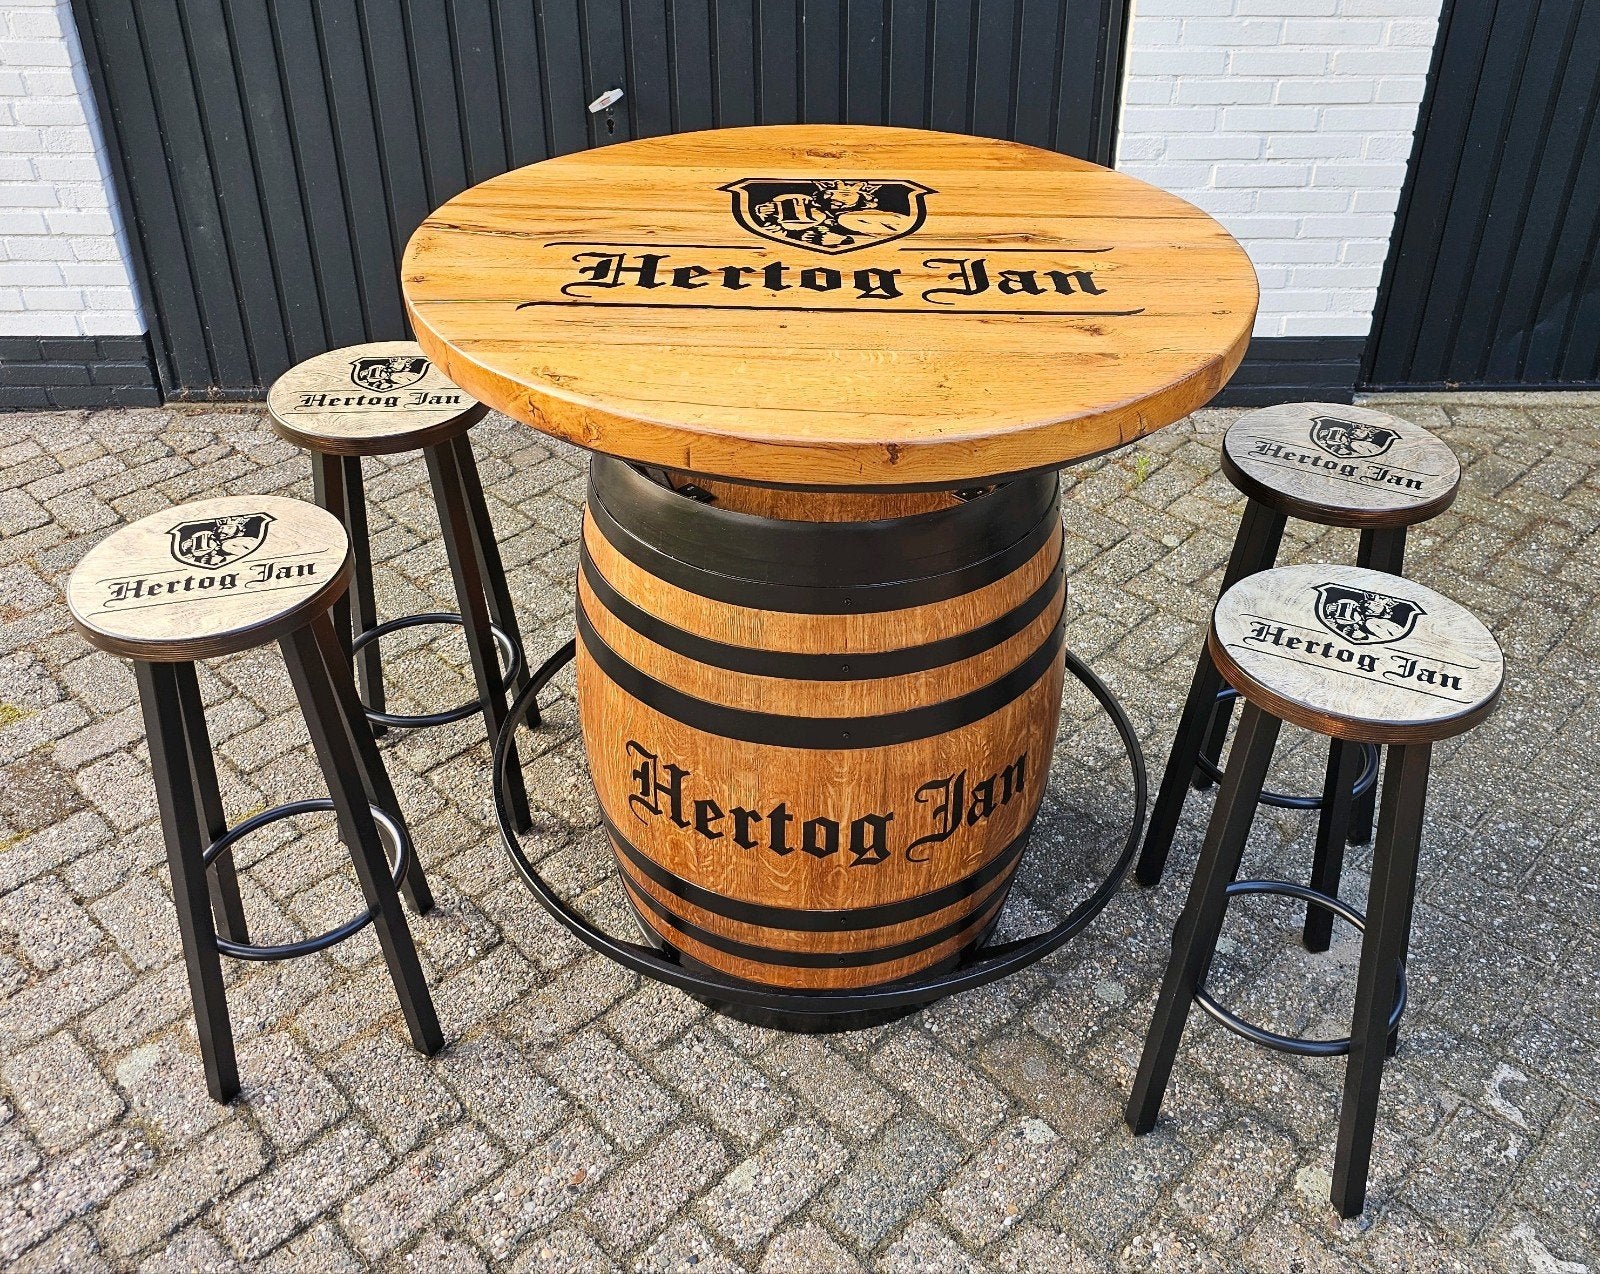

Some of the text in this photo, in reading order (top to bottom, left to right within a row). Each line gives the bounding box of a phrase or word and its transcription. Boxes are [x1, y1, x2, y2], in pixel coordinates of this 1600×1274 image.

[561, 252, 1107, 305] Hertog Jan
[294, 392, 461, 411] Hertog Jan
[1248, 440, 1424, 491] Hertog Jan
[103, 562, 317, 607] Hertog Jan
[1242, 621, 1462, 691] Hertog Jan
[626, 740, 1028, 867] Hertog Jan
